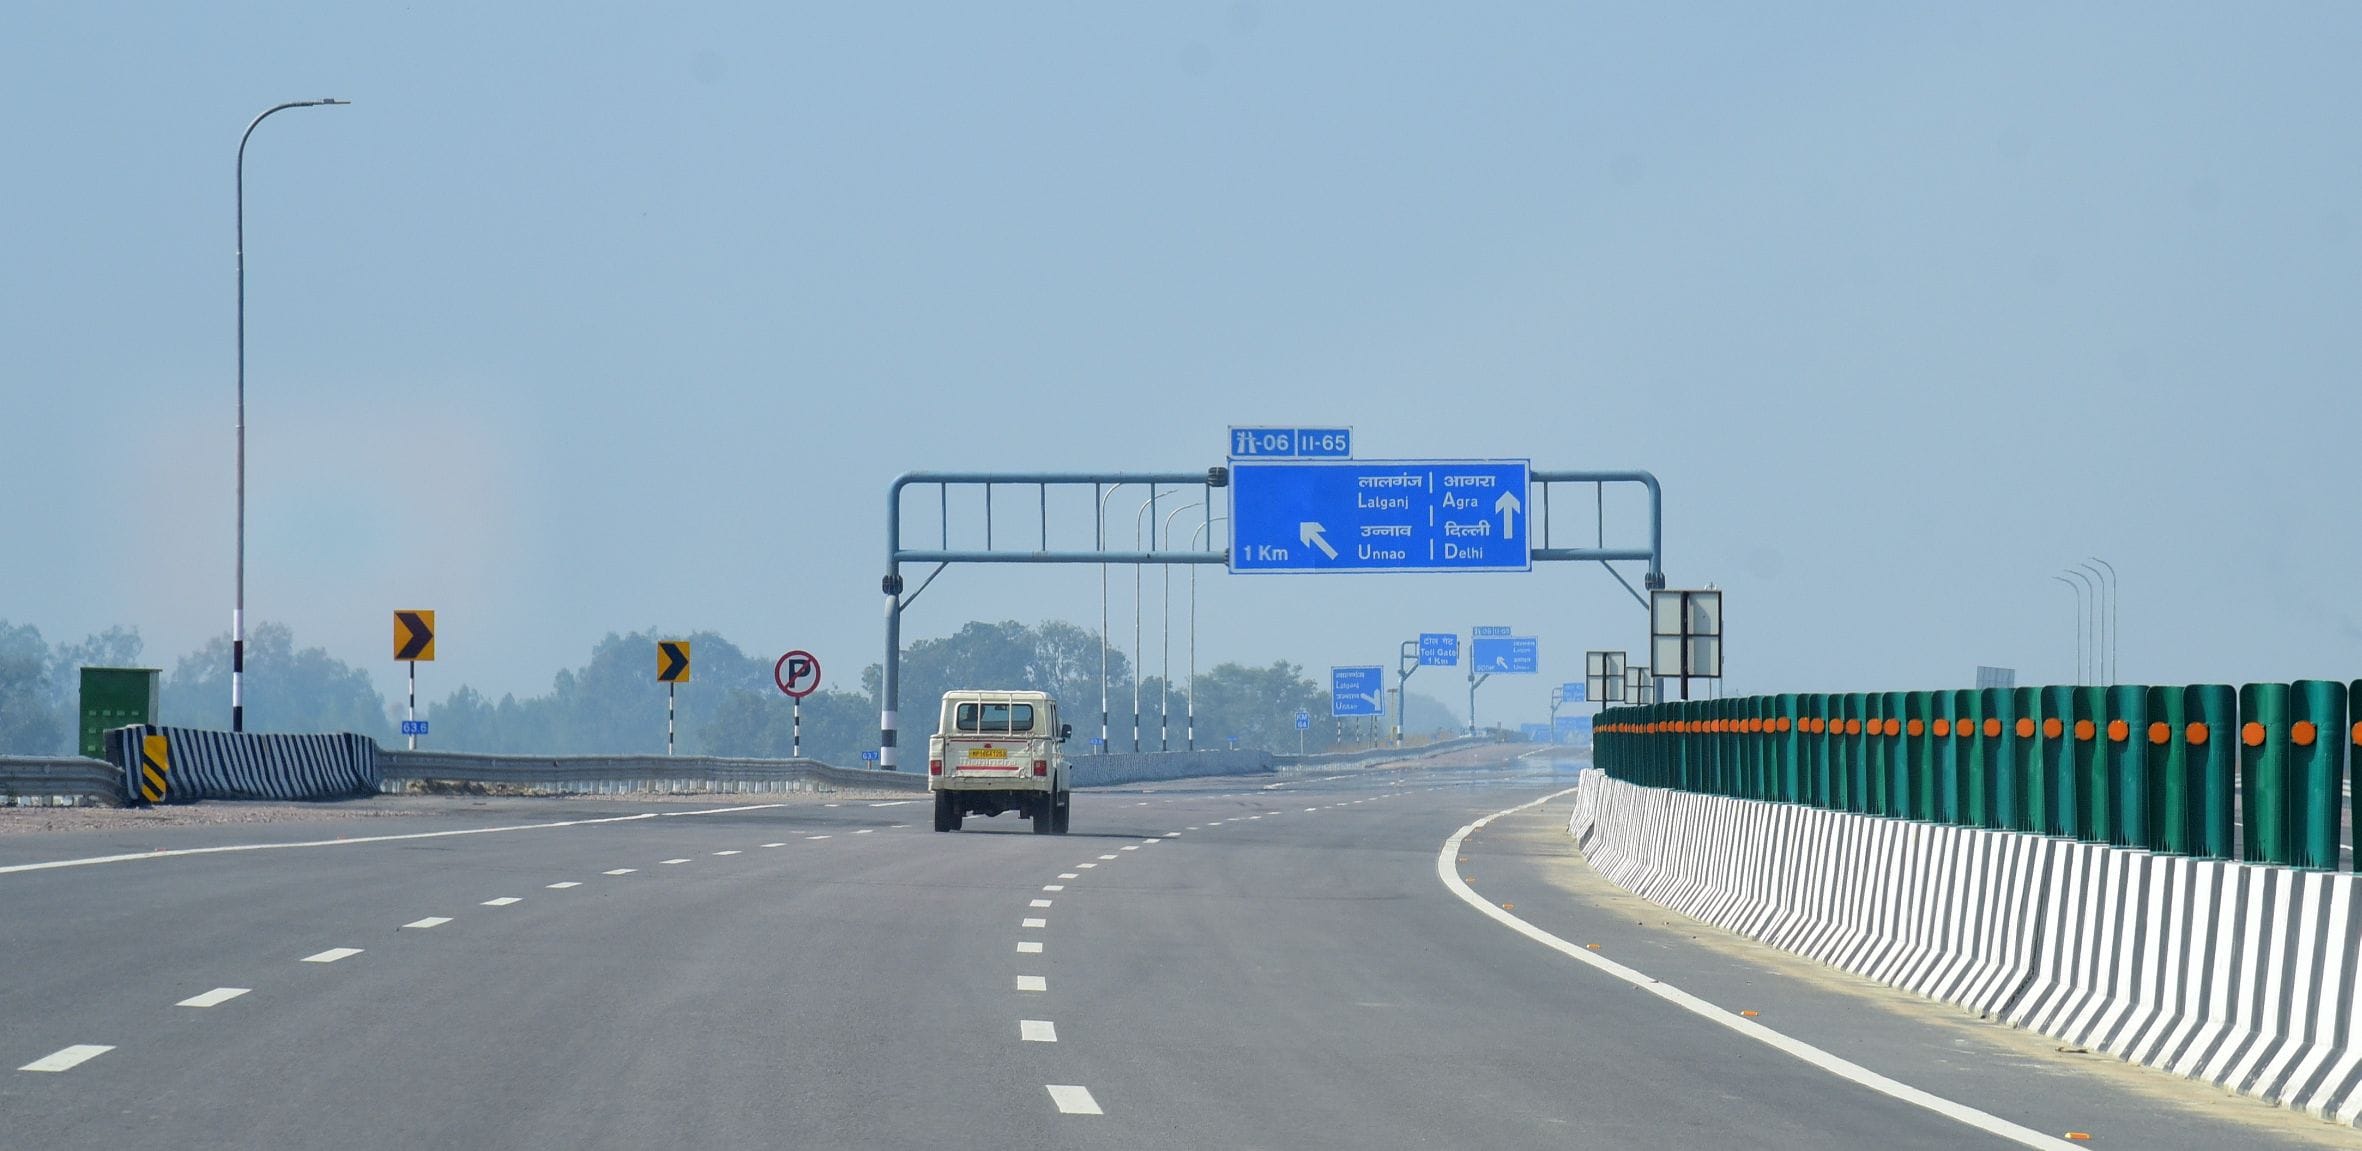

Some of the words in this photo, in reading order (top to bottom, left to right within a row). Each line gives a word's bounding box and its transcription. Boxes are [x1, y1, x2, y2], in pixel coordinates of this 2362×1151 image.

[1358, 472, 1422, 488] लालगंज
[1443, 475, 1496, 488] आगरा
[1358, 491, 1409, 510] Lalganj
[1442, 491, 1478, 510] Agra
[1360, 525, 1413, 537] उन्नाव
[1444, 519, 1491, 537] दिल्ली
[1243, 545, 1251, 561] 1
[1258, 544, 1289, 561] Km
[1358, 543, 1406, 560] Unnao
[1445, 543, 1483, 560] Delhi
[1421, 648, 1435, 657] Toll
[1437, 648, 1456, 657] Gate
[403, 722, 427, 733] 63.6
